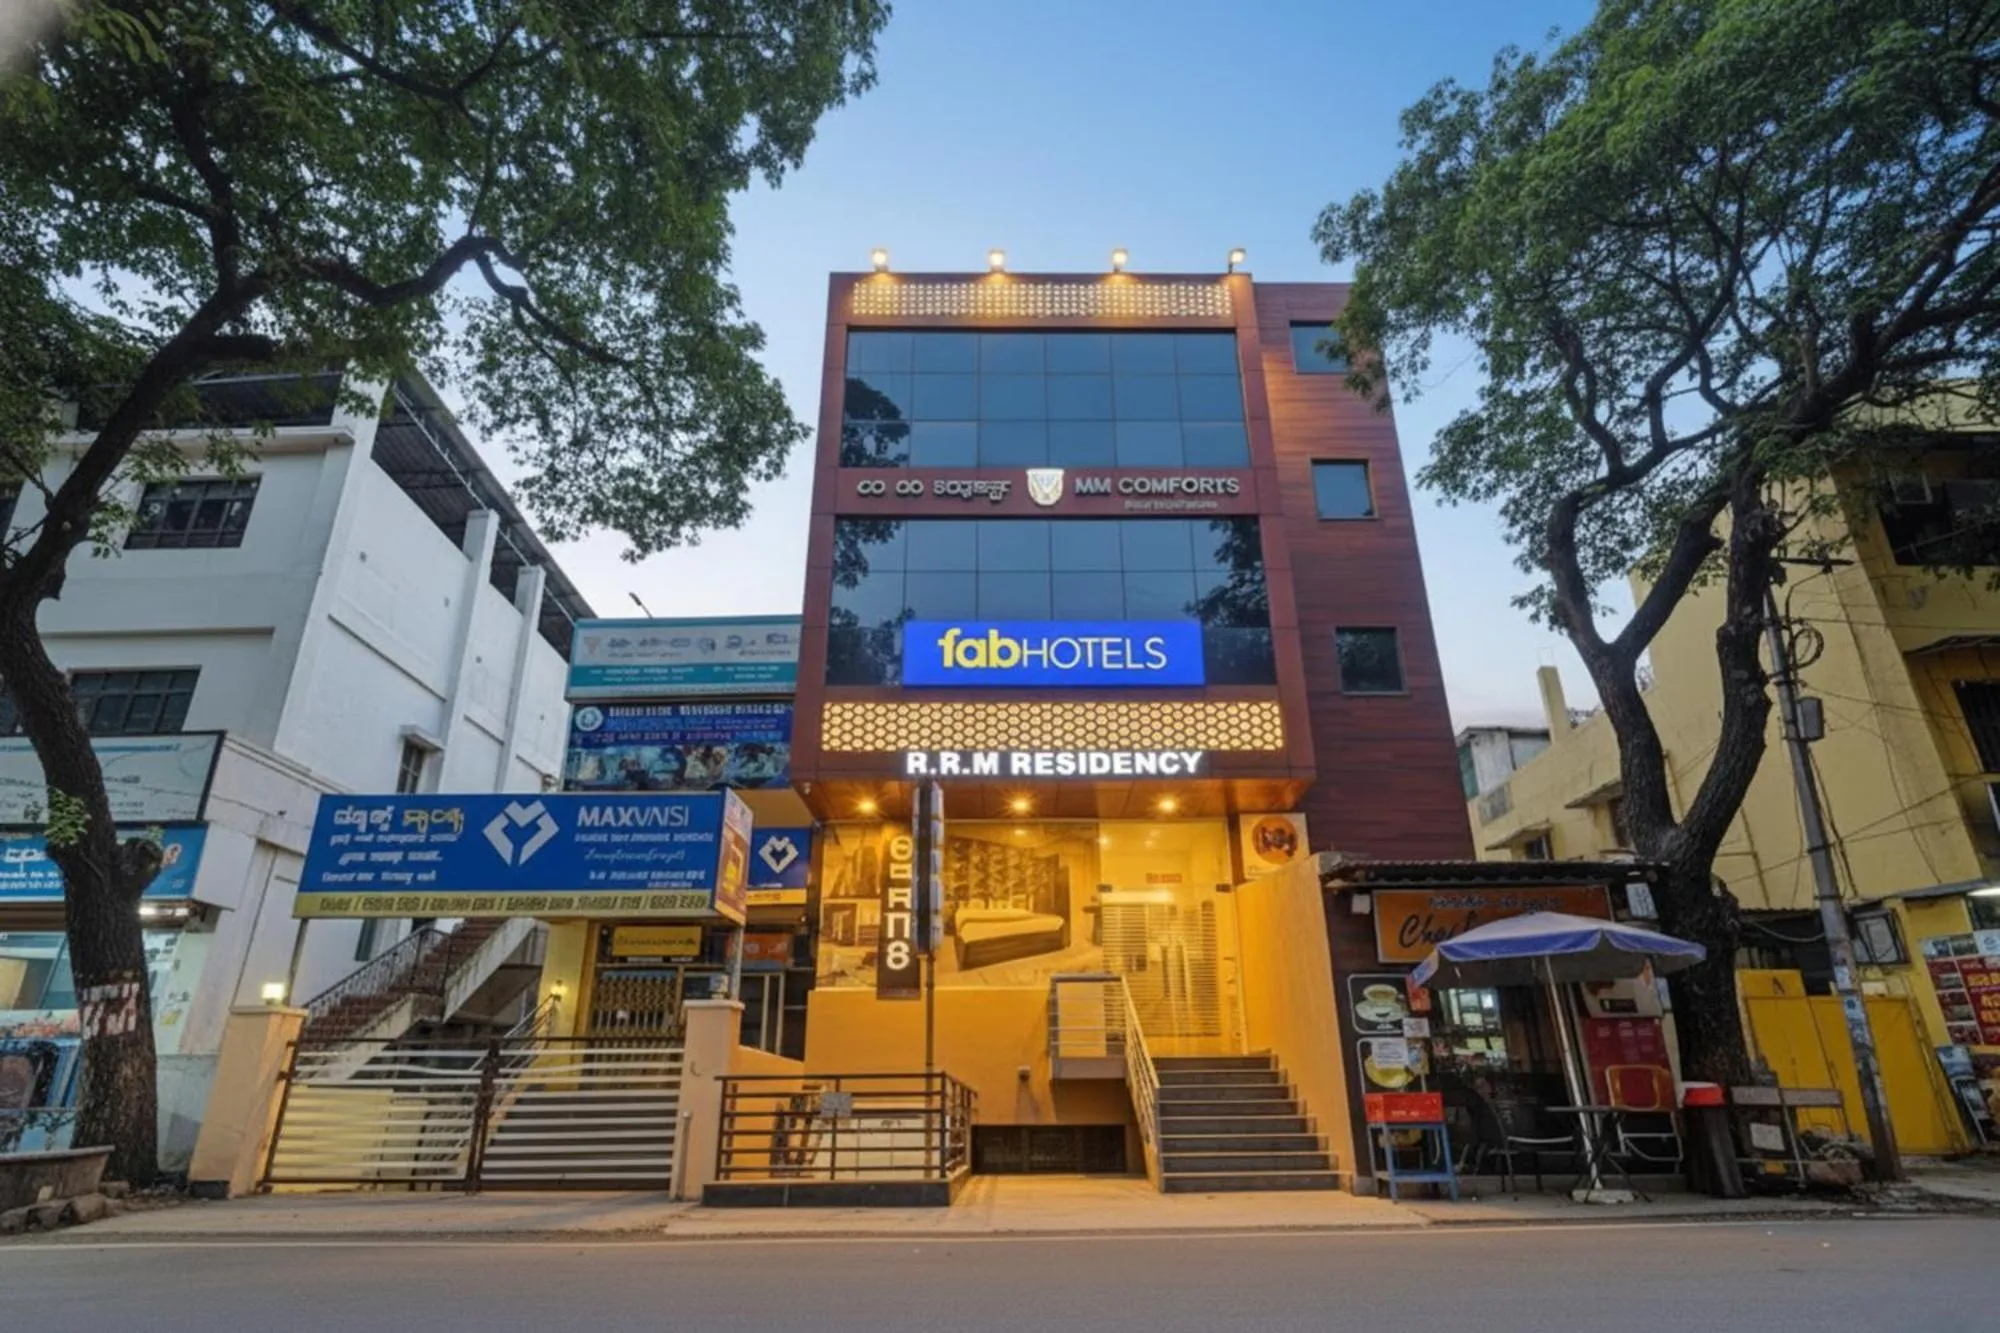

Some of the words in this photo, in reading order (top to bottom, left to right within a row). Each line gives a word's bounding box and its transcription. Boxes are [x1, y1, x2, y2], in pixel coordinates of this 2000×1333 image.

[1075, 477, 1112, 494] MM
[1118, 476, 1241, 495] COMFORTS
[906, 751, 999, 775] R.R.M
[1010, 751, 1203, 775] RESIDENCY
